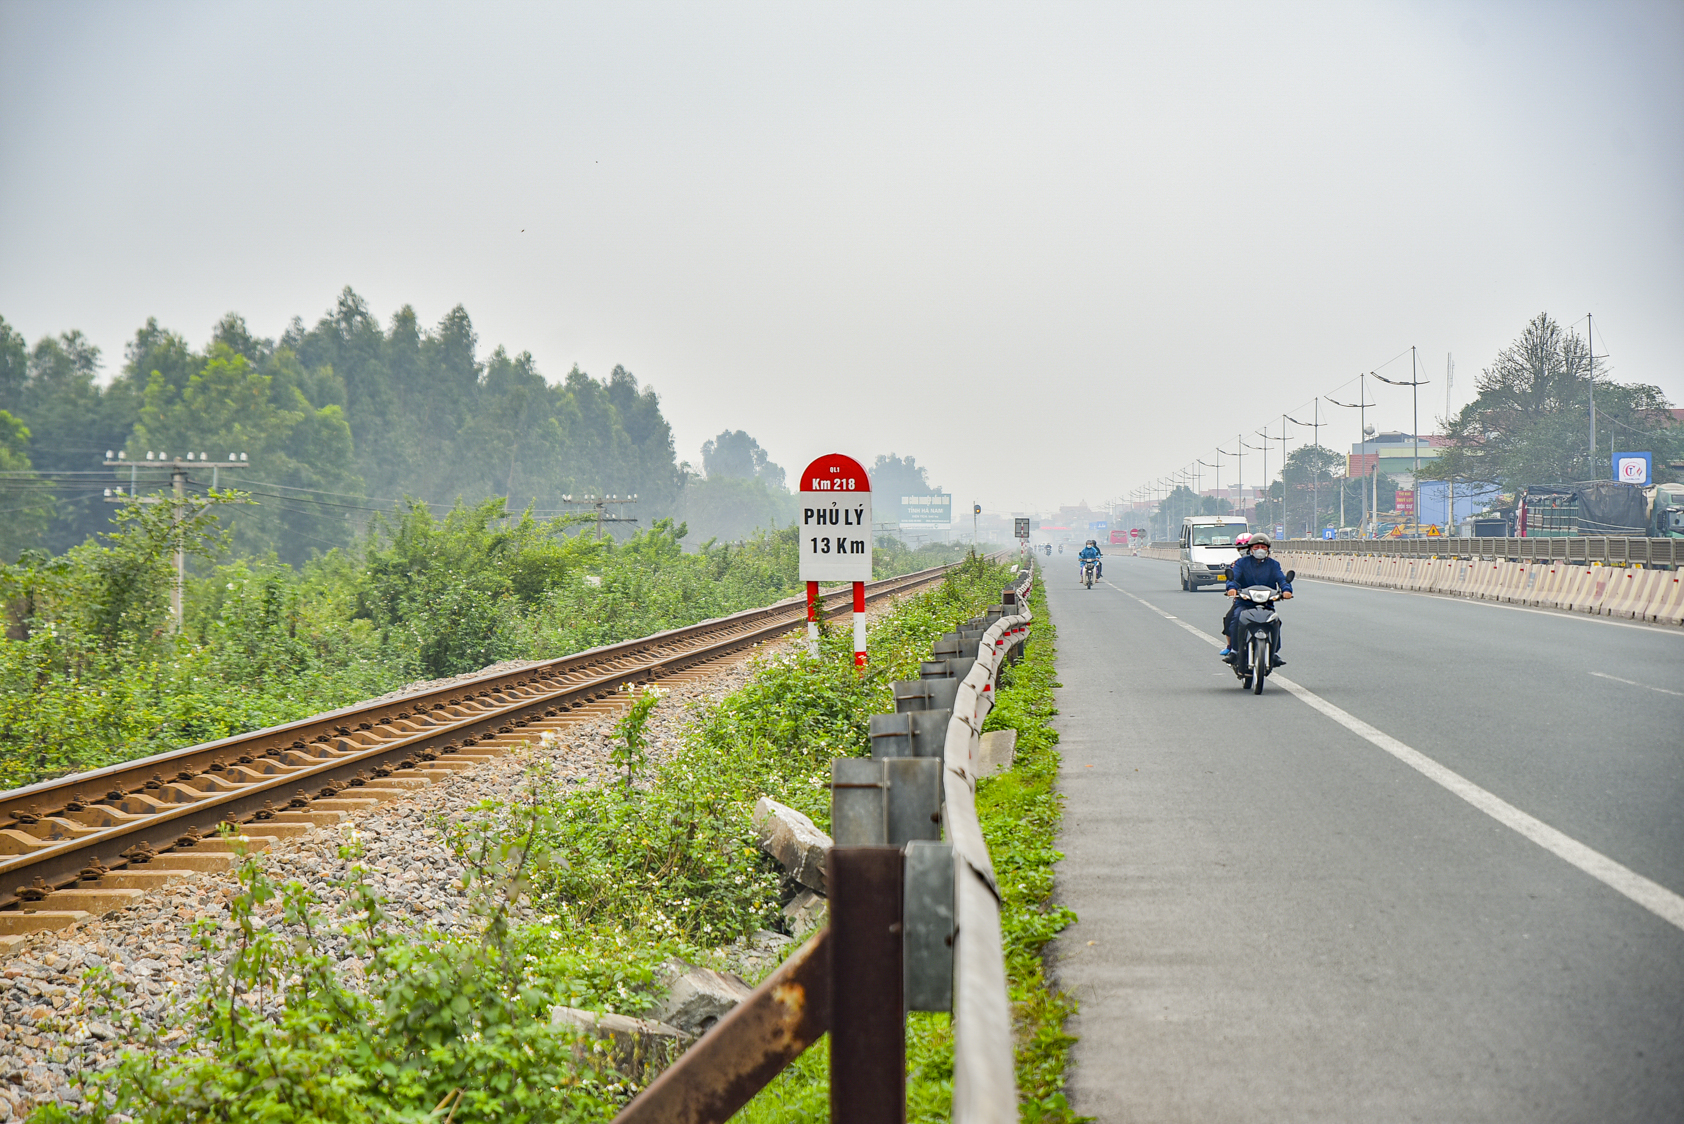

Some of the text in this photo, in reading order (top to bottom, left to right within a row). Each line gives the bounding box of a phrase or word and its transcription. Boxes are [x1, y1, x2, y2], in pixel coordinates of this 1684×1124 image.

[812, 478, 855, 490] Km 218
[804, 502, 864, 525] PHỦ LÝ
[811, 537, 865, 554] 13 Km
